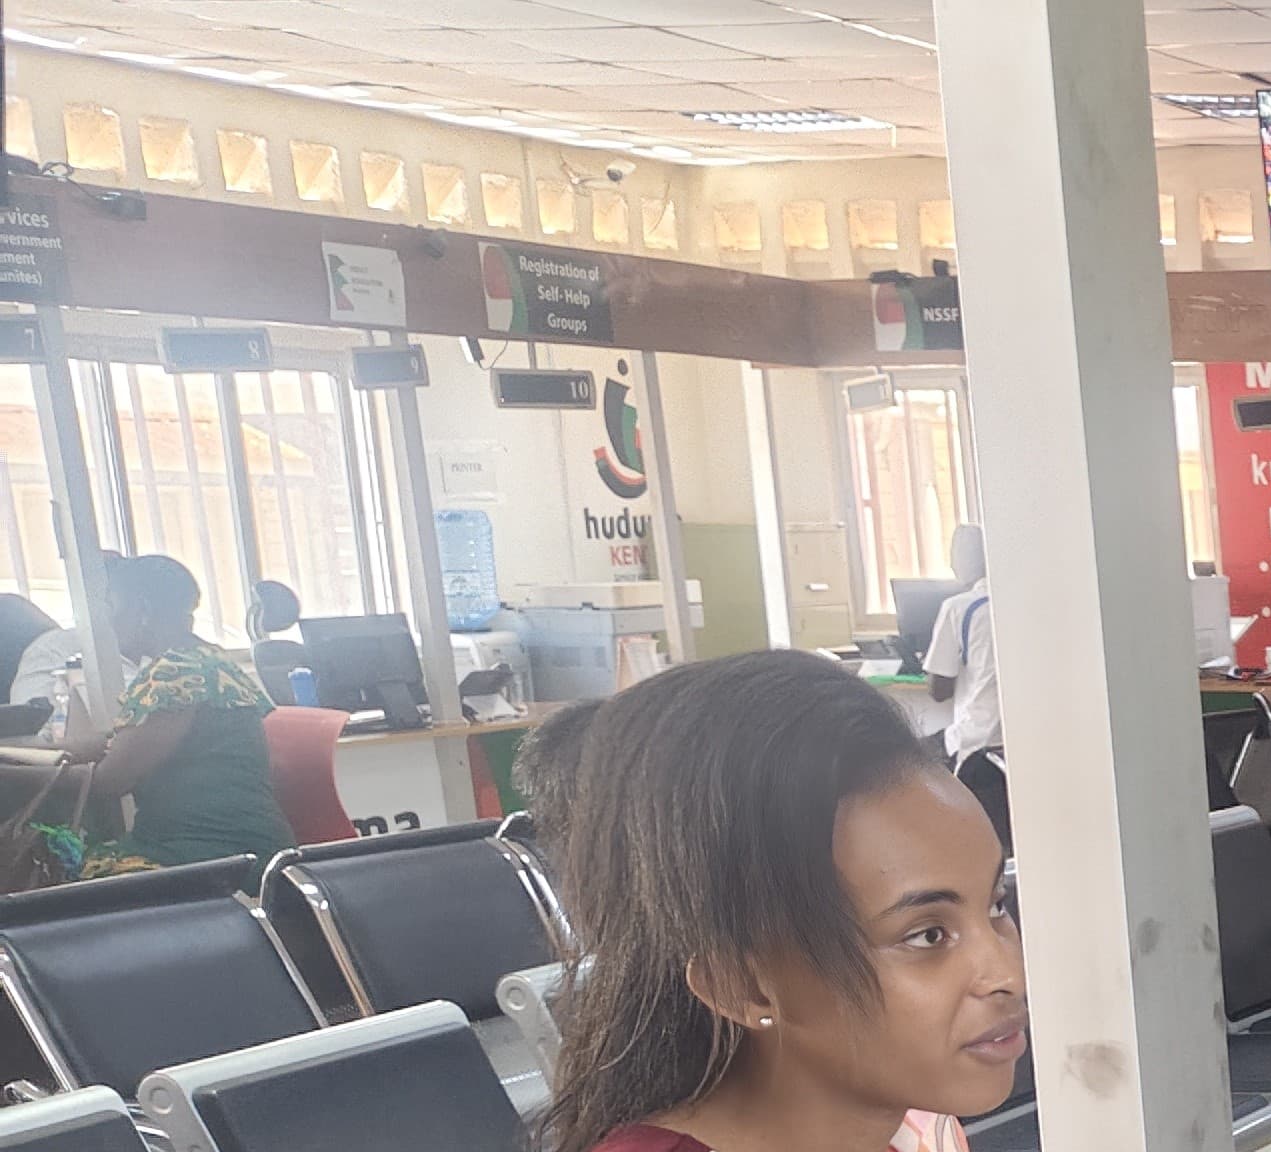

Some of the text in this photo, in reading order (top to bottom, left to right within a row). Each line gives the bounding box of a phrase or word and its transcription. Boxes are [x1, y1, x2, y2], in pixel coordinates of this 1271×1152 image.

[519, 255, 600, 281] Registration of
[547, 312, 588, 335] Groups
[922, 306, 959, 322] NSSF
[570, 380, 589, 400] 10
[583, 506, 652, 540] hudu
[609, 545, 648, 566] KEN
